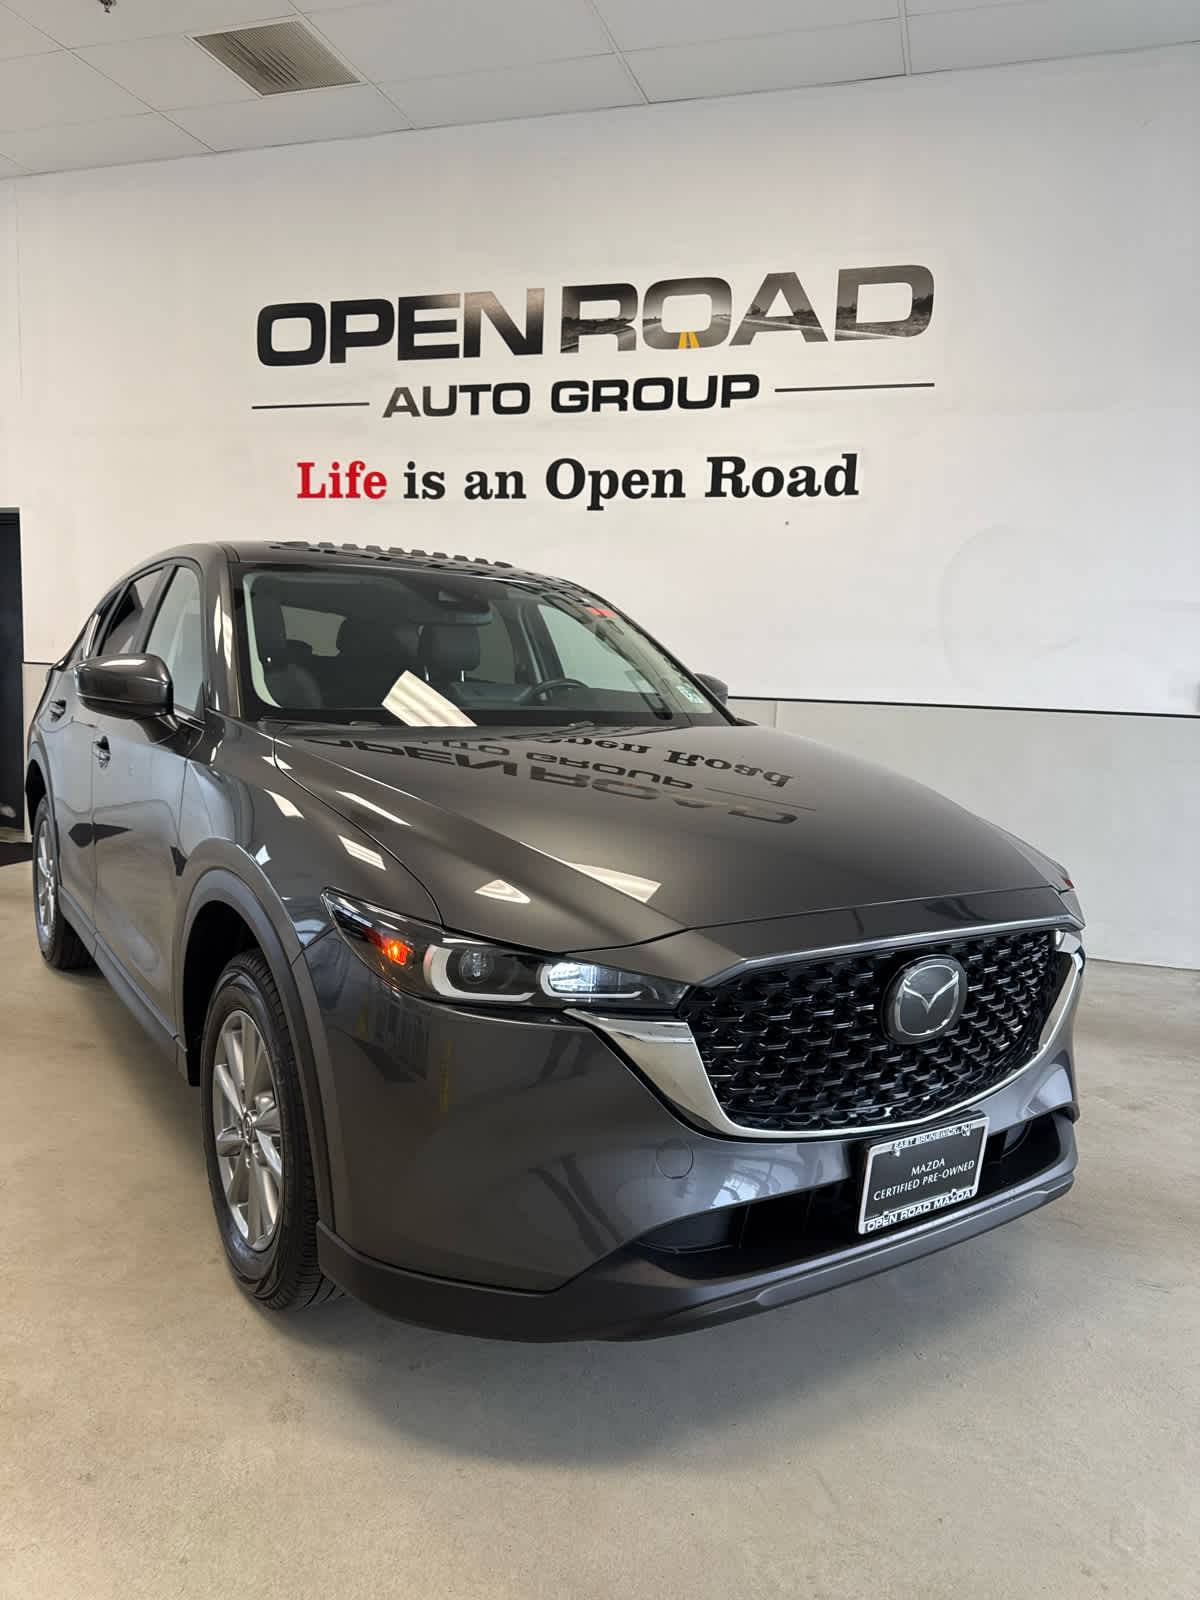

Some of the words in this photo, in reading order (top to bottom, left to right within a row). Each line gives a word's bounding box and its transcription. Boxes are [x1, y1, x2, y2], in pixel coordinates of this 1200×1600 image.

[257, 288, 544, 366] OPEN
[560, 265, 934, 353] ROAD
[382, 382, 530, 418] AUTO
[551, 374, 759, 413] GROUP
[297, 461, 387, 499] Life
[403, 461, 445, 500] is
[464, 470, 526, 500] an
[546, 458, 686, 511] Open
[705, 453, 859, 498] Road
[873, 1178, 920, 1201] CERTIFIED
[922, 1160, 975, 1185] PRE-OWNED
[911, 1157, 945, 1176] MAZDA
[867, 1212, 898, 1231] OPEN
[900, 1201, 931, 1220] ROAD
[933, 1190, 971, 1209] MAZDA
